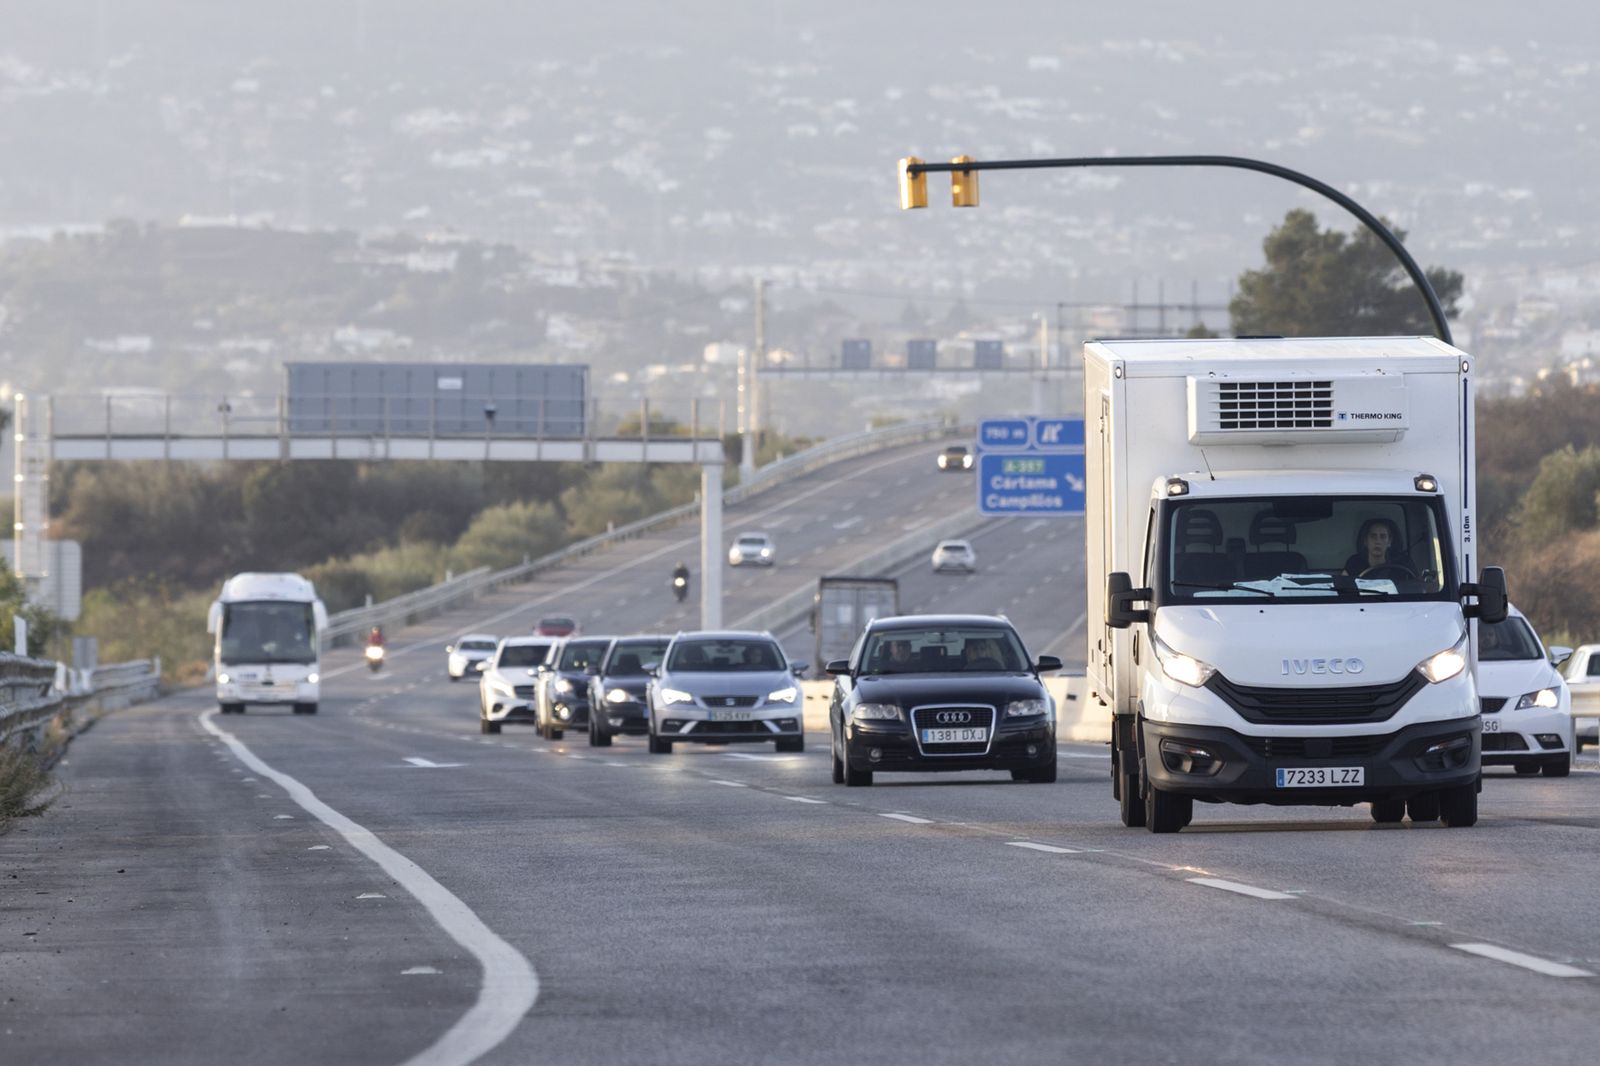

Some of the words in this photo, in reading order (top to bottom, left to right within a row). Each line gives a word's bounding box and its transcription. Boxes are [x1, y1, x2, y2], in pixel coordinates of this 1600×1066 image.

[1012, 429, 1025, 438] m
[986, 493, 1063, 510] Campillos
[1281, 658, 1364, 675] IVECO
[931, 730, 957, 741] 1381
[962, 730, 984, 740] DXJ
[1288, 770, 1325, 784] 7233
[1331, 769, 1360, 784] LZZ
